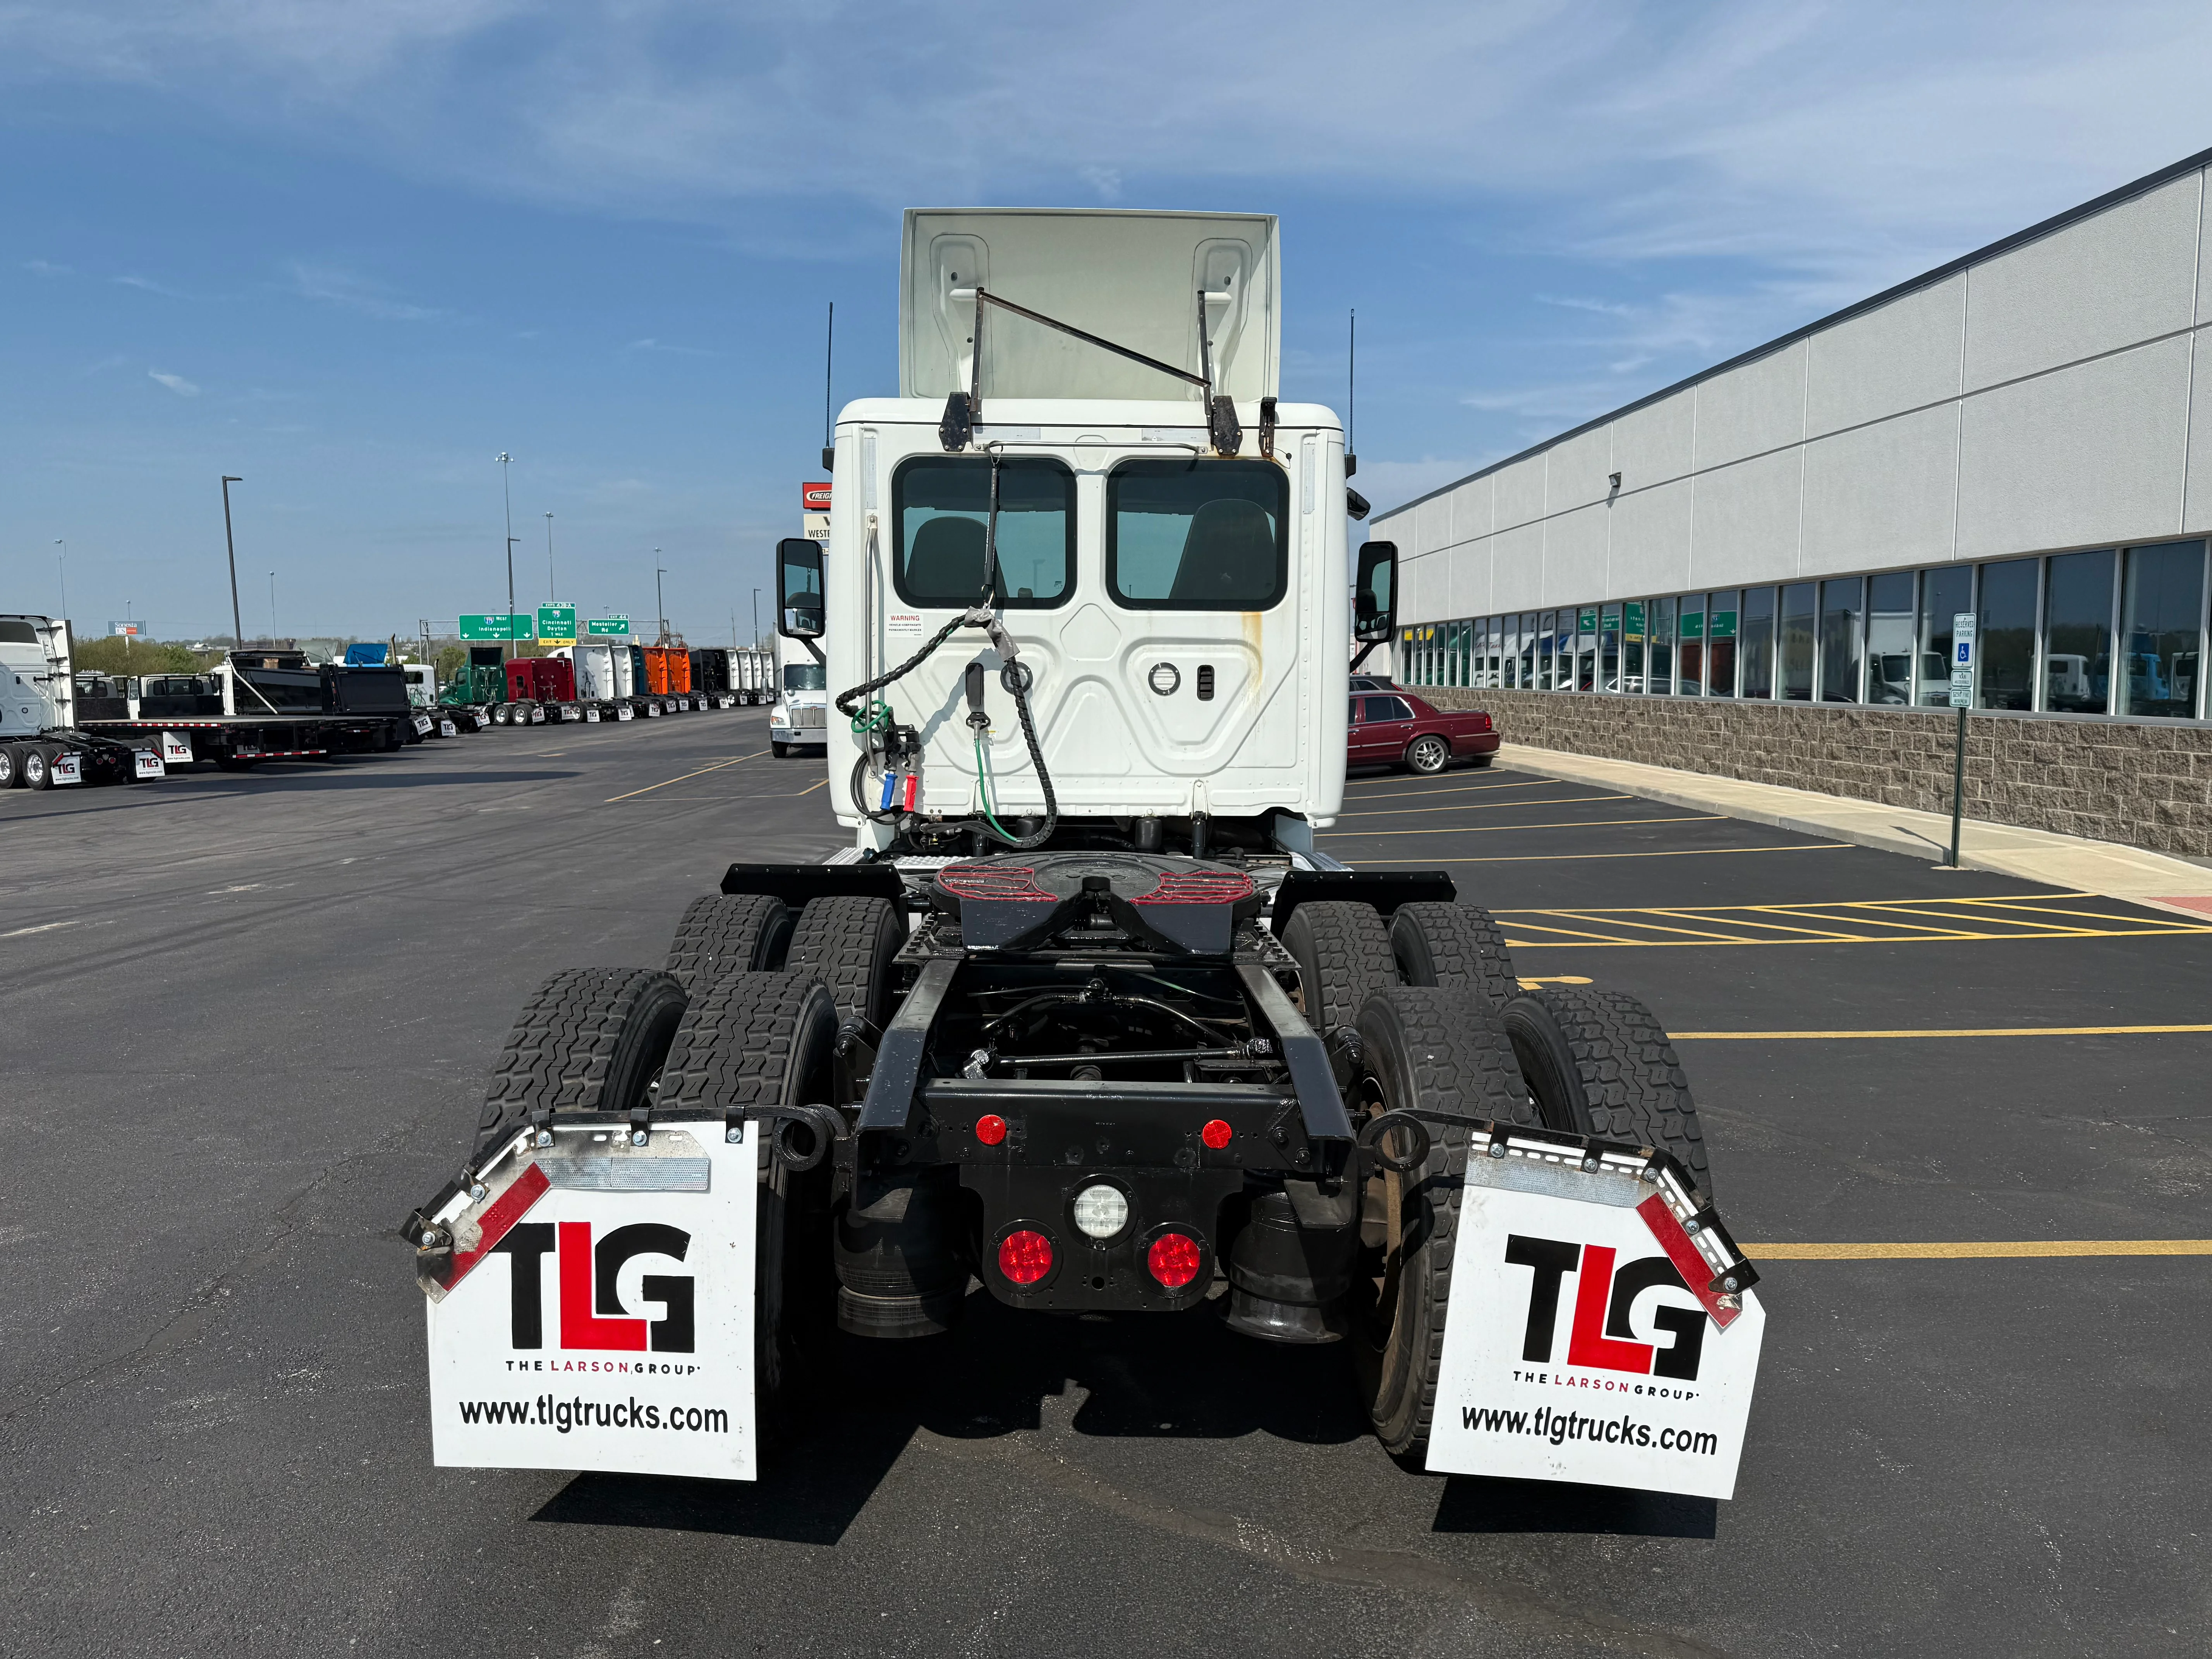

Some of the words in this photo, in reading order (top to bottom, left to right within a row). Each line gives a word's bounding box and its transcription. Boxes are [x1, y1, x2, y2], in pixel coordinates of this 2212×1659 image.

[168, 745, 187, 754] TLG
[55, 763, 75, 774] TLG
[139, 757, 159, 768] TLG
[488, 1221, 695, 1353] TLG
[1504, 1233, 1709, 1382] TLG
[505, 1360, 543, 1371] THE
[551, 1360, 629, 1374] LARSON
[1513, 1370, 1548, 1384] THE
[1554, 1374, 1630, 1393] LARSON
[459, 1394, 729, 1434] www.tlgtrucks.com
[1462, 1406, 1718, 1455] www.tlgtrucks.com
